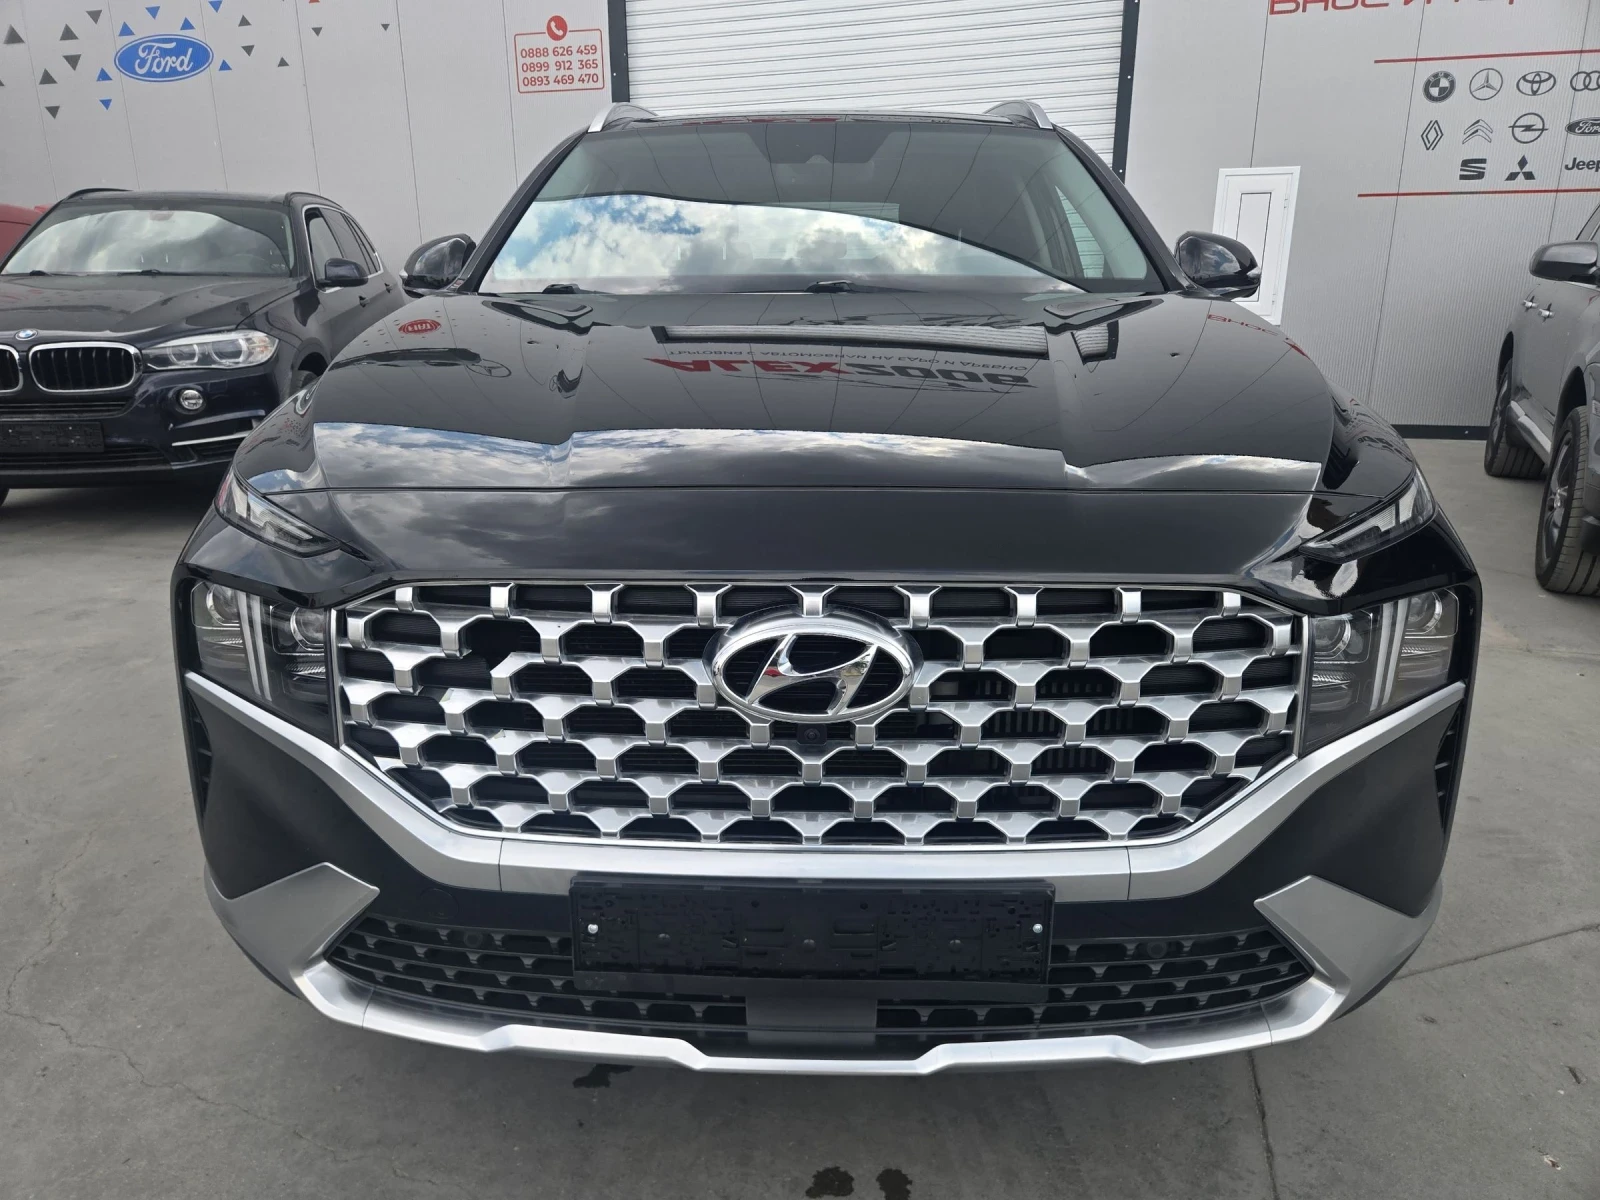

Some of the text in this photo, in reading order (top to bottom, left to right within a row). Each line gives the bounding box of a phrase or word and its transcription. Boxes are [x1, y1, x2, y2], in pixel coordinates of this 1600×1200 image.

[520, 44, 597, 58] 0888 626 459
[134, 41, 194, 75] Ford
[521, 59, 598, 72] 0899 912 365
[522, 73, 599, 86] 0893 469 470
[1575, 120, 1600, 133] For
